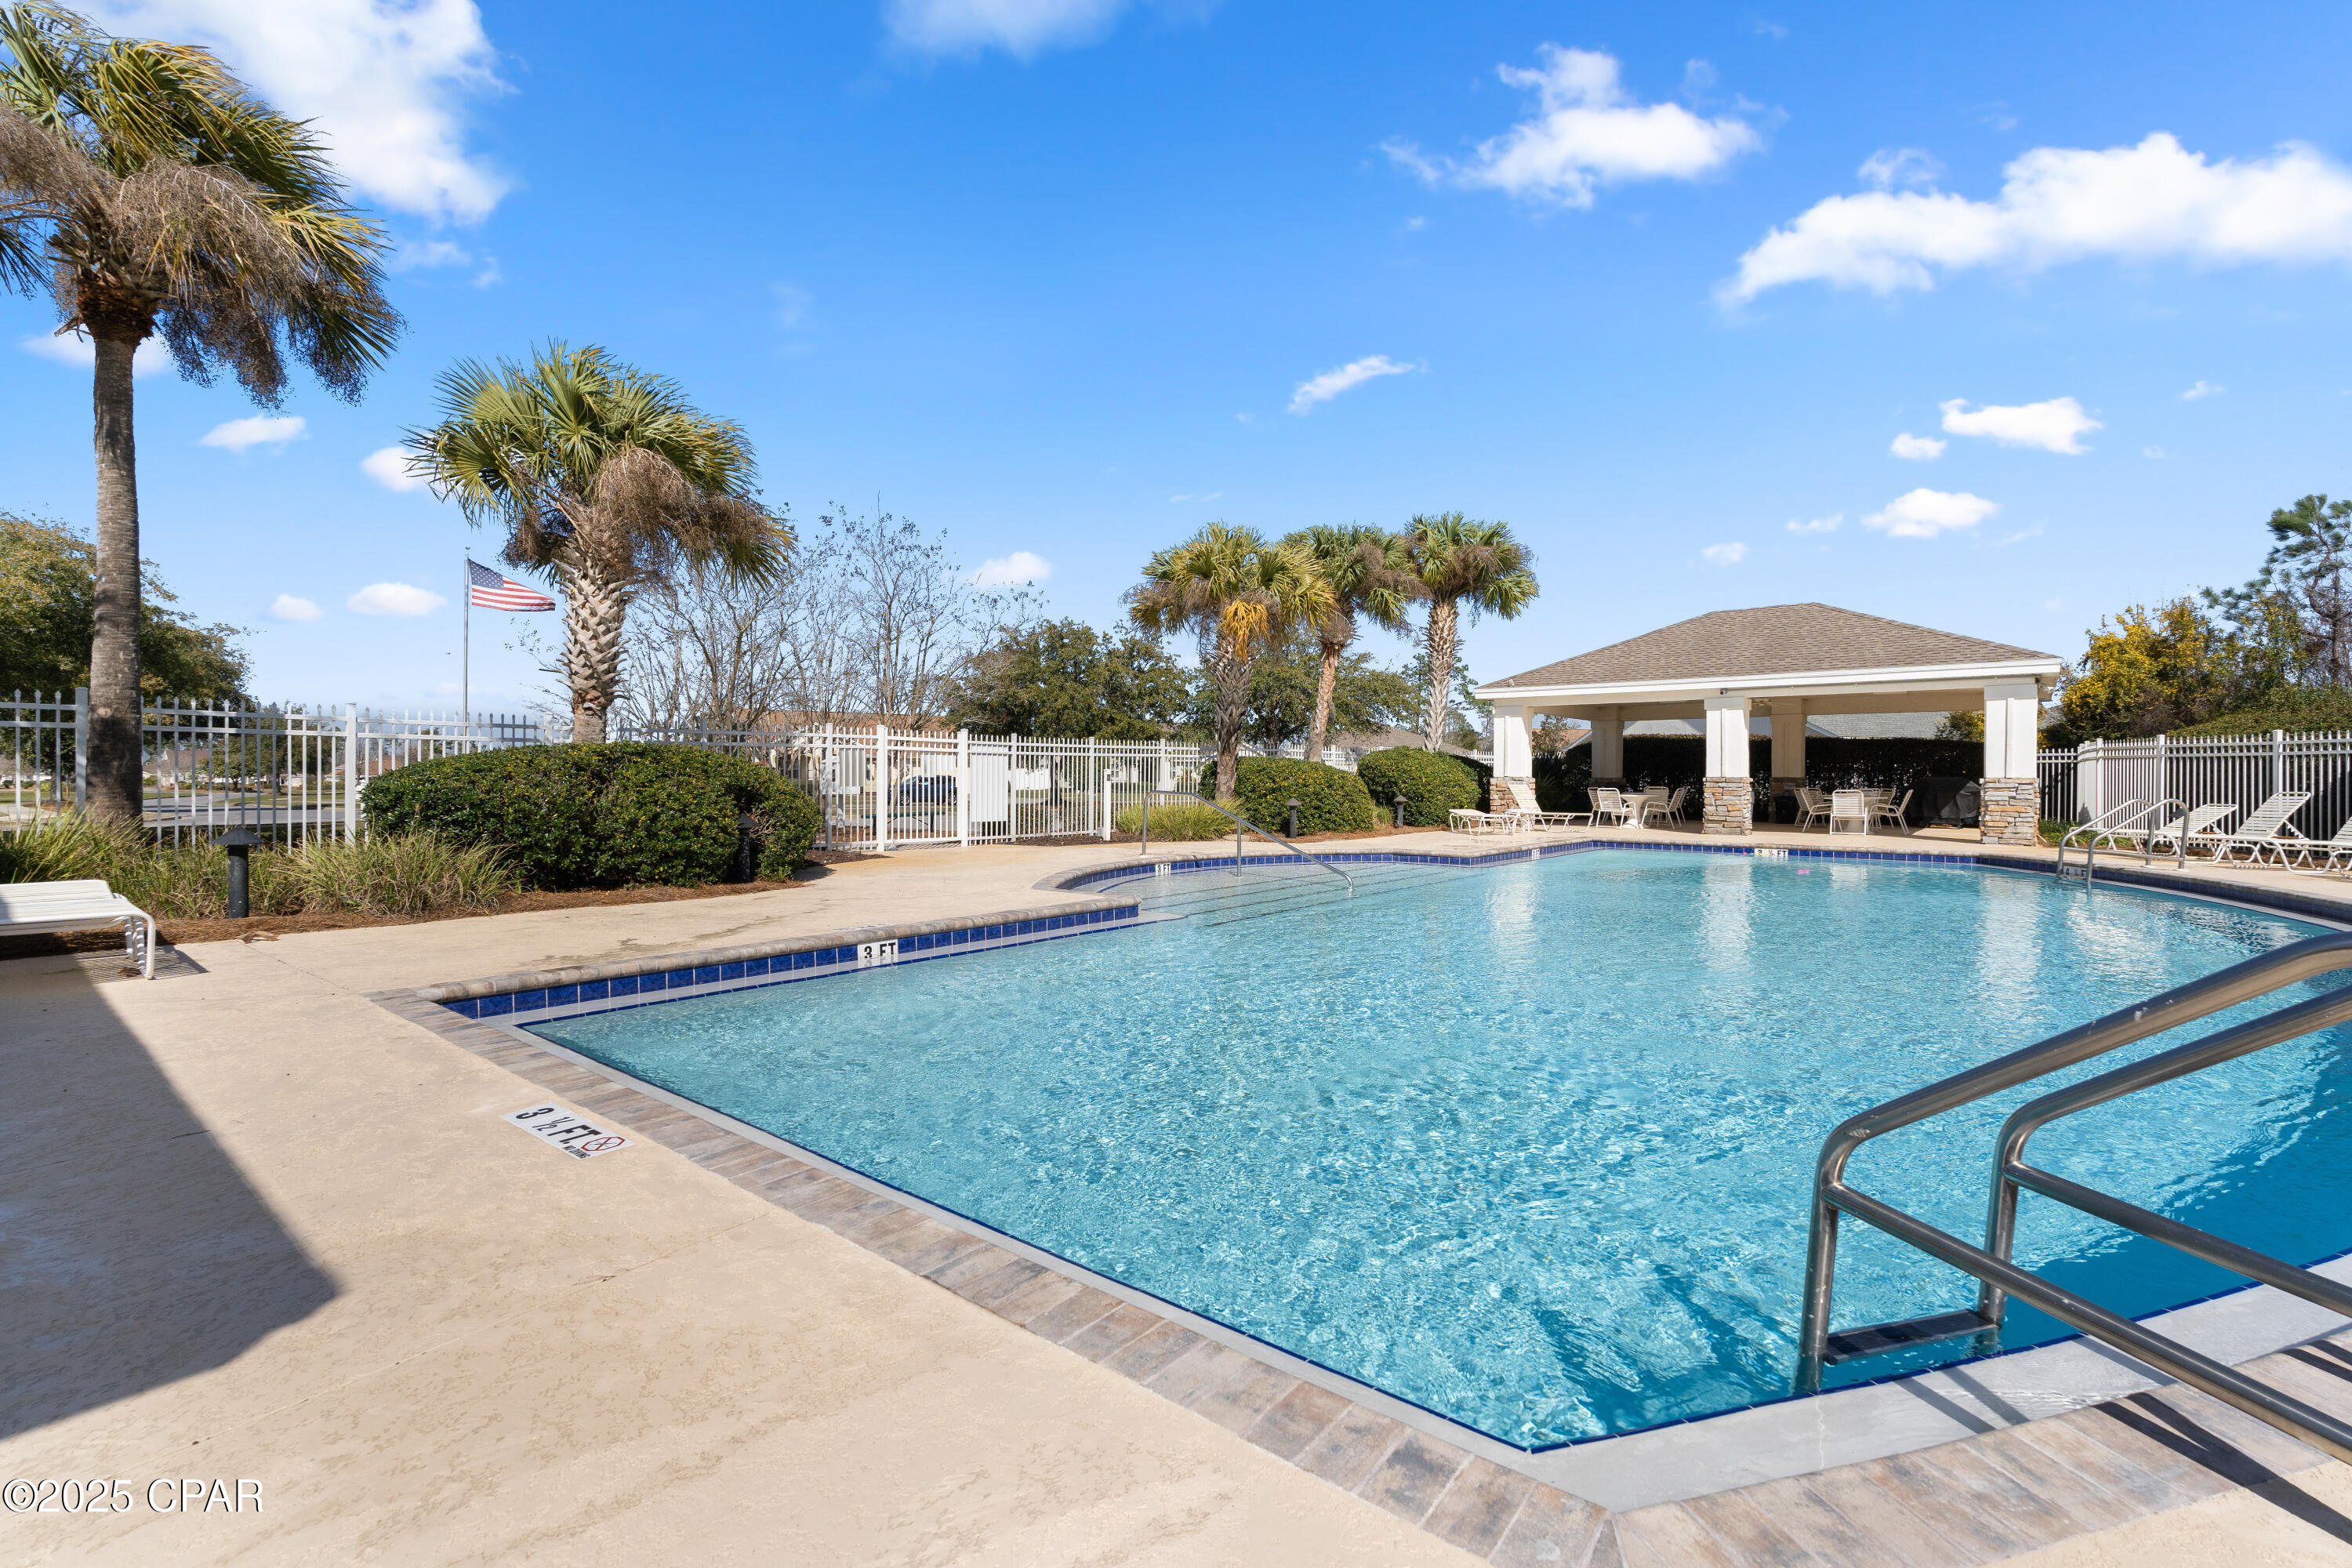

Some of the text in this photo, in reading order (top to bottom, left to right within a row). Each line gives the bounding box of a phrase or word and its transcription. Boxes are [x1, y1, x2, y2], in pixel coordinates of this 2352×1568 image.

[864, 942, 896, 959] 3 FT
[516, 1107, 554, 1120] 3
